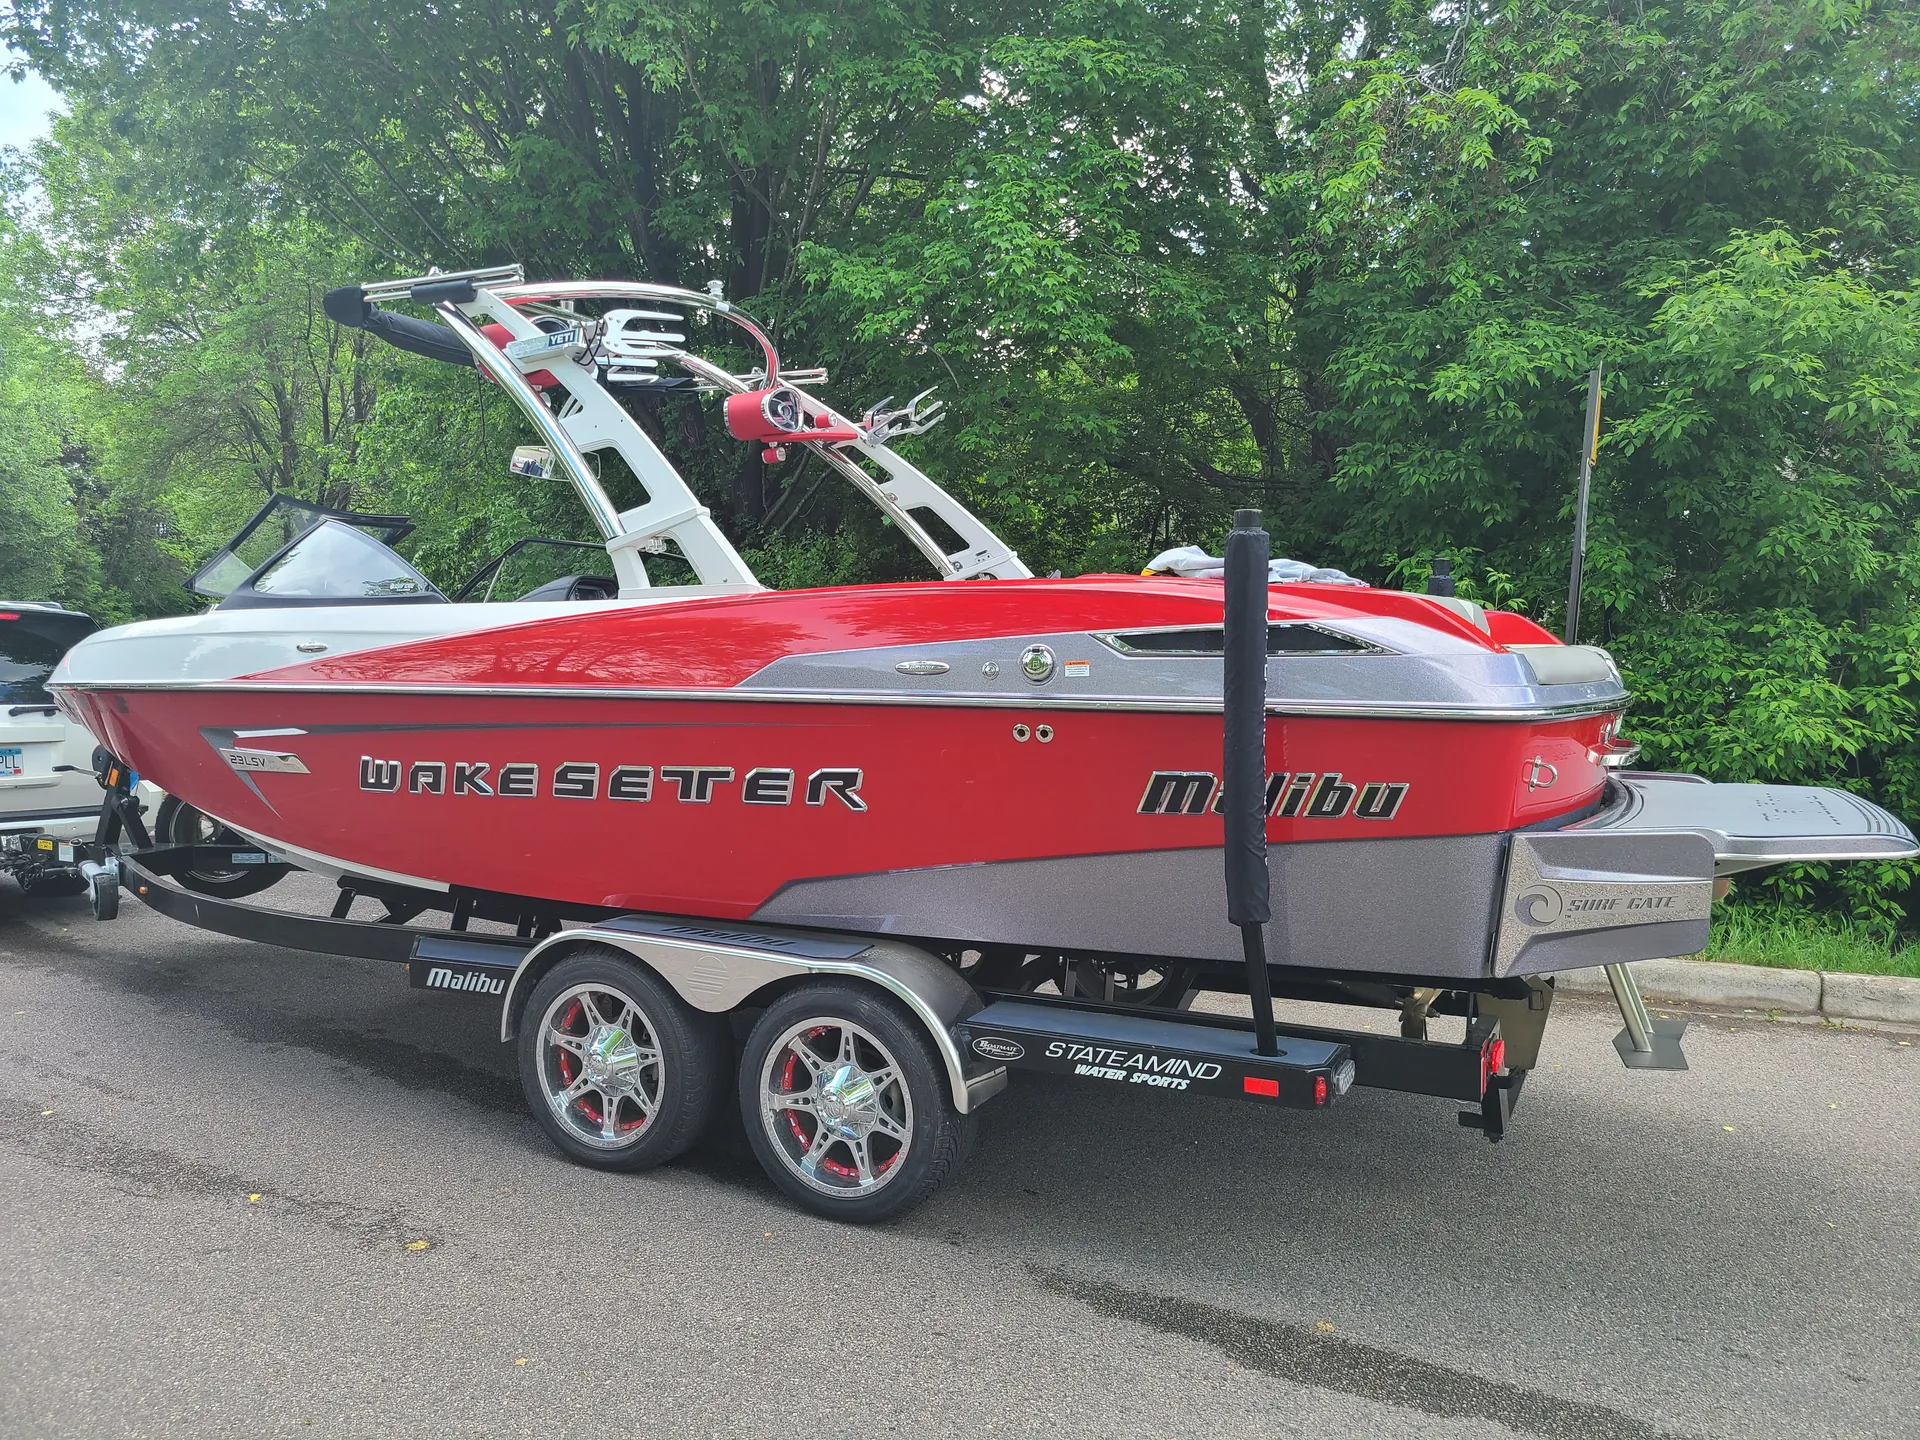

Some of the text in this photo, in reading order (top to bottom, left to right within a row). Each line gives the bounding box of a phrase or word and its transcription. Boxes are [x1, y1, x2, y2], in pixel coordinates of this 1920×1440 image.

[550, 332, 574, 345] YETI
[230, 755, 265, 767] 23LSV
[1136, 770, 1410, 820] Mlibu
[1567, 895, 1679, 912] SURF GATE
[1074, 1063, 1190, 1091] WATER SPORTS
